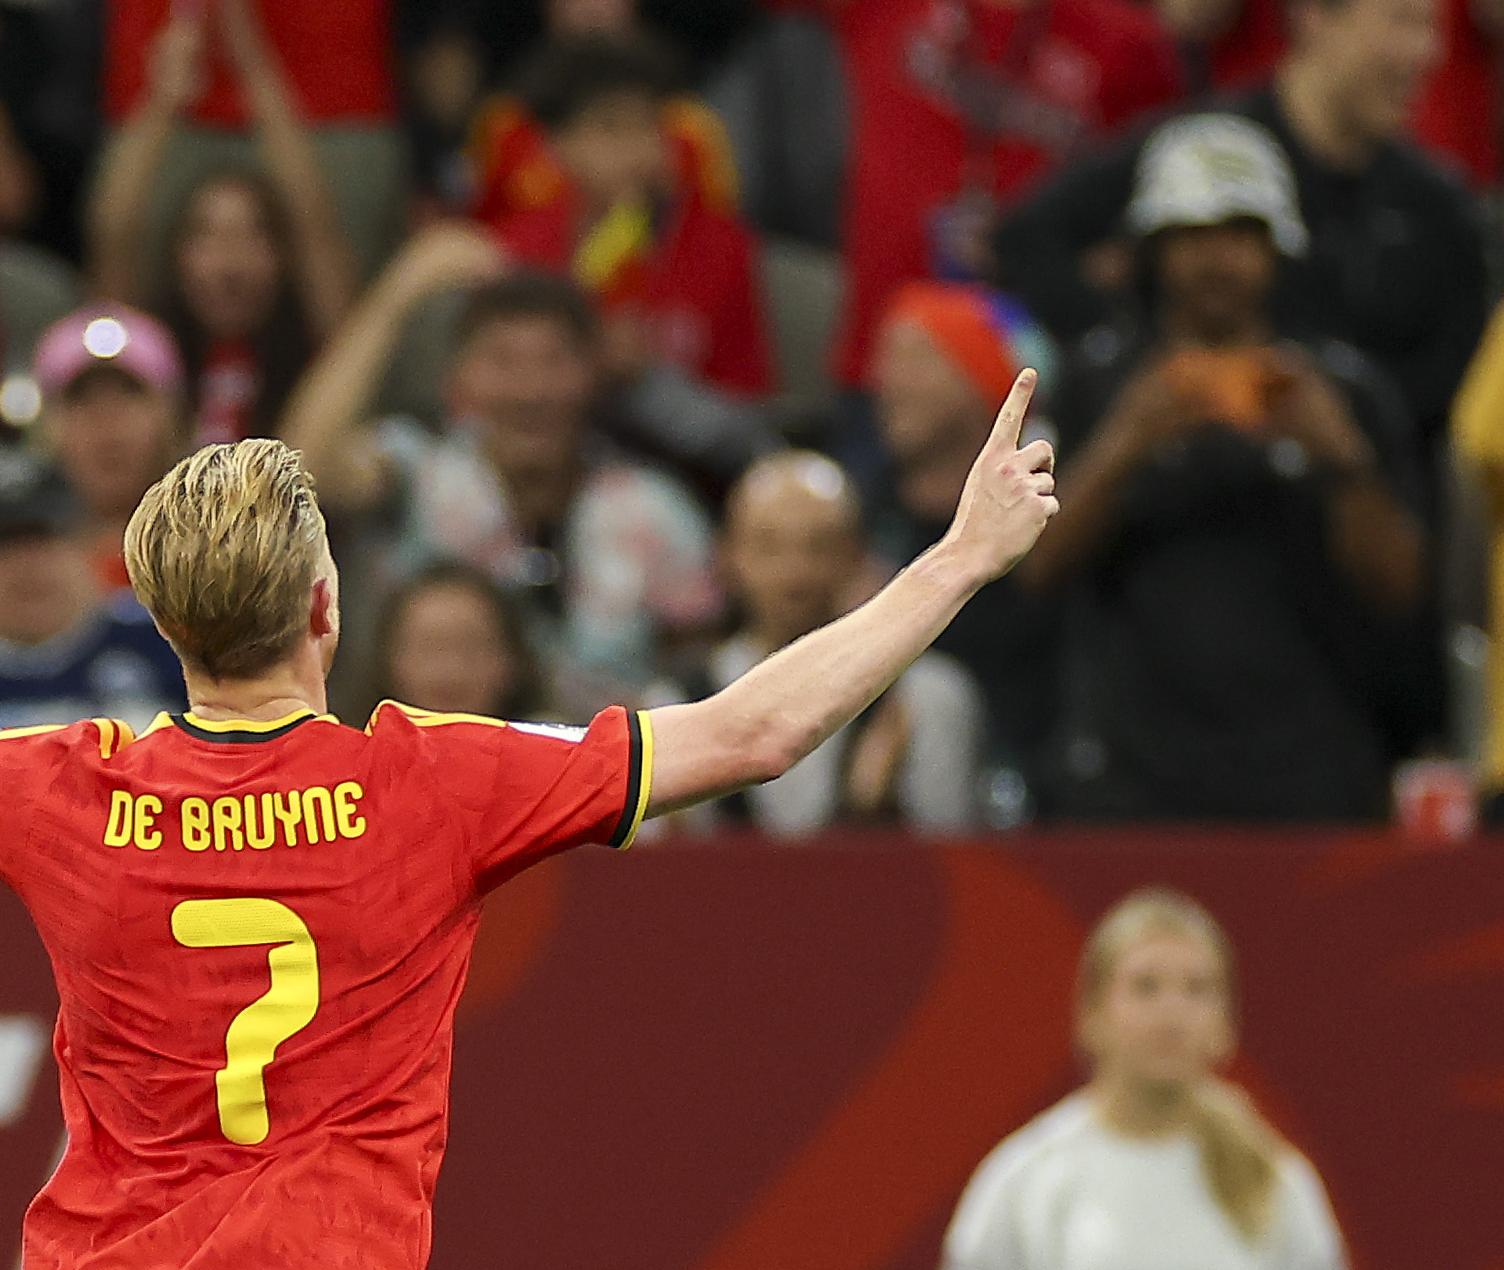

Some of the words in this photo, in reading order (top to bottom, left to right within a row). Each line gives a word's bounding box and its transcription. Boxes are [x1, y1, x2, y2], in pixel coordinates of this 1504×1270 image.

[103, 789, 164, 851] DE
[180, 781, 367, 852] BRUYNE
[170, 896, 321, 1146] 7
